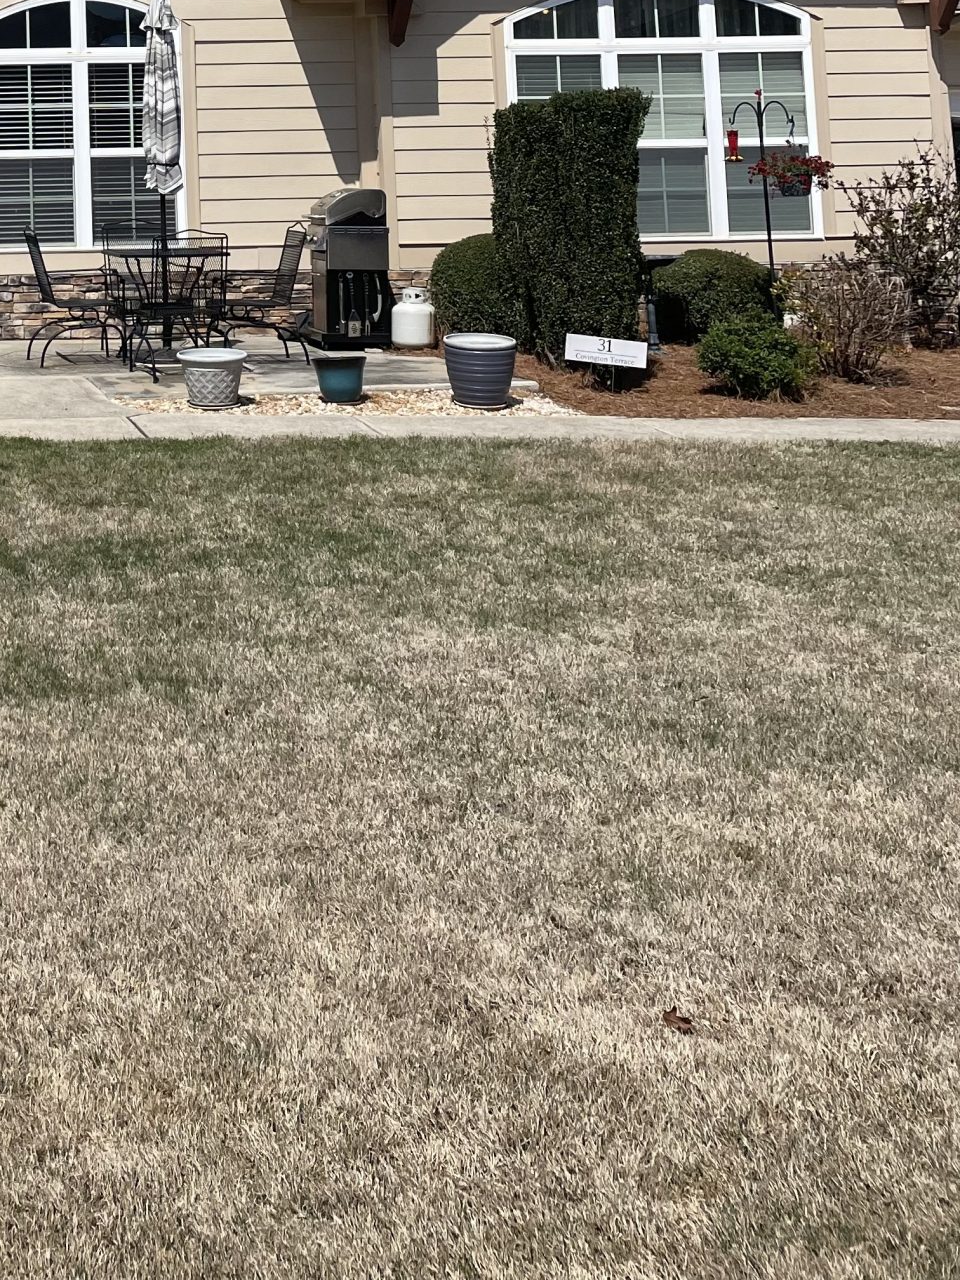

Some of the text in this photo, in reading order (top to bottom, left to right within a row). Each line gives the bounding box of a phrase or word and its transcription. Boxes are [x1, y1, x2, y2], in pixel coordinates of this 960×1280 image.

[597, 338, 613, 353] 31
[575, 352, 635, 366] Covington Terrace
